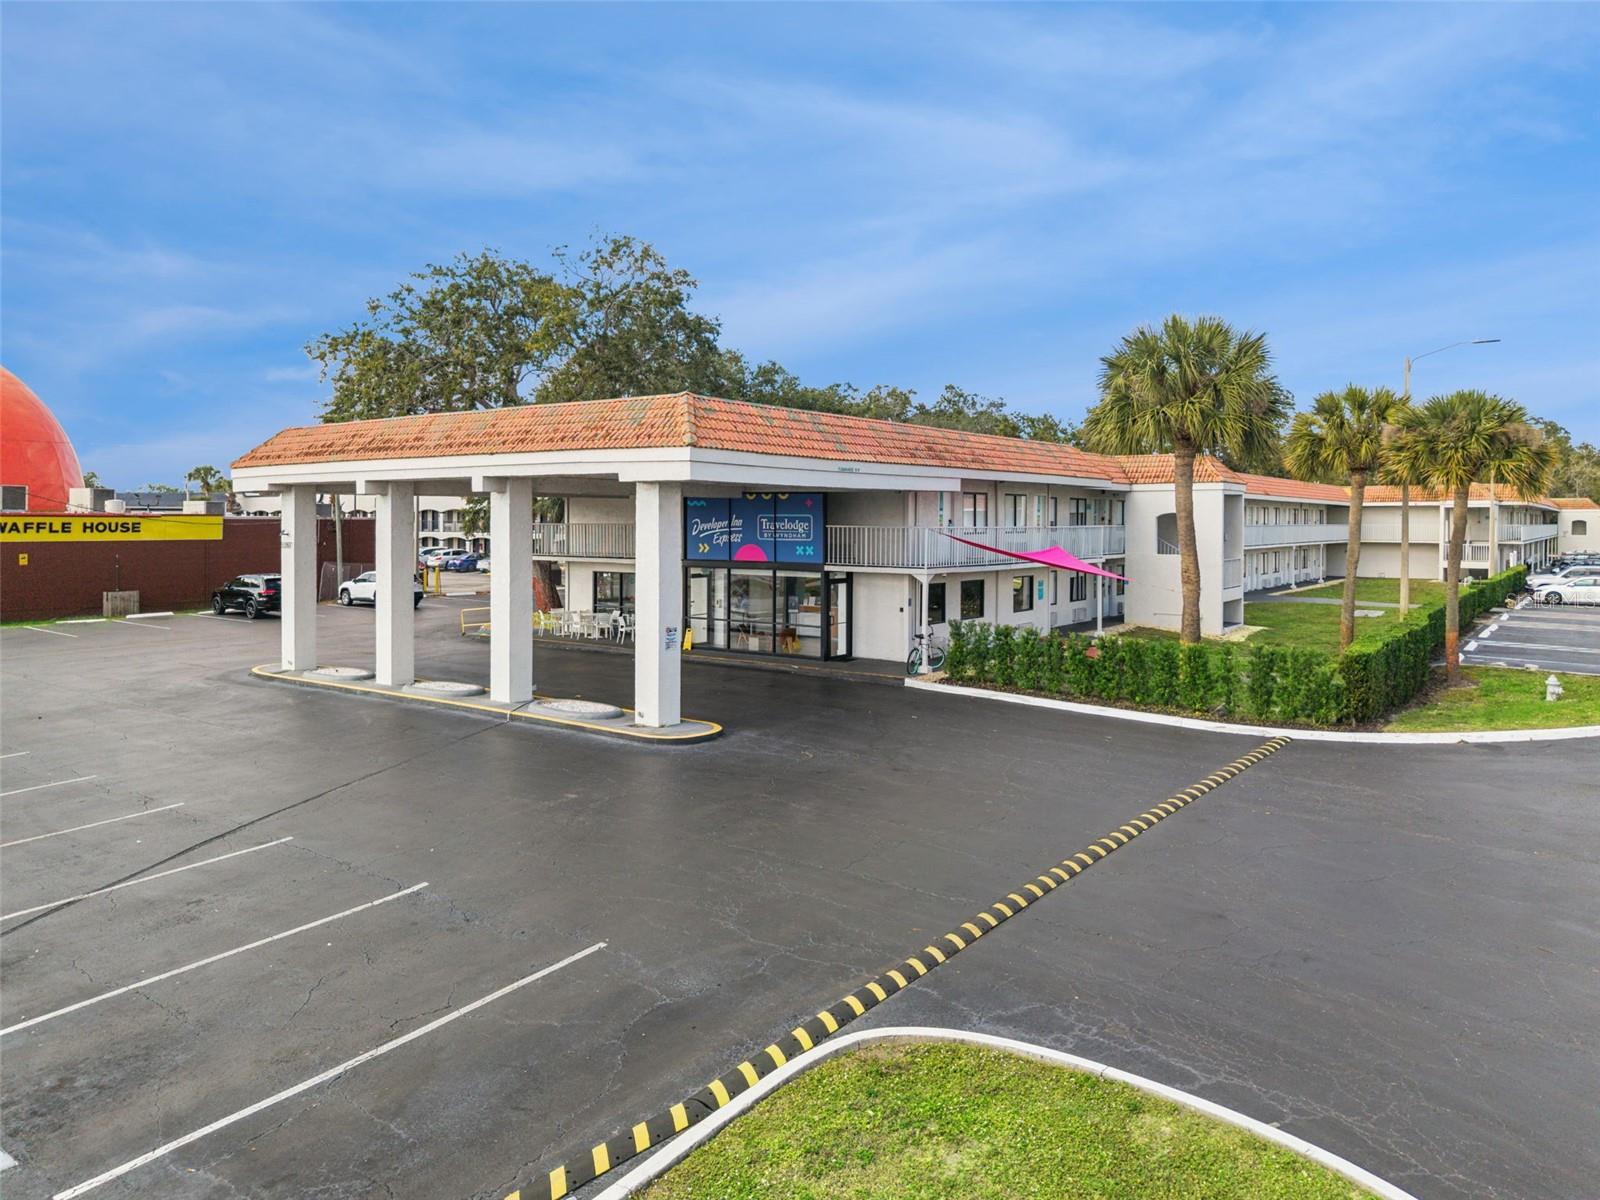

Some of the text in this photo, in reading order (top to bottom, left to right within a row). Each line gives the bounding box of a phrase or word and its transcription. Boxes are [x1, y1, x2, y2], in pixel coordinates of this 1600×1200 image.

[82, 522, 142, 533] HOUSE
[691, 513, 743, 535] Developer Inn
[760, 518, 809, 533] Travelodge
[713, 532, 743, 547] Express
